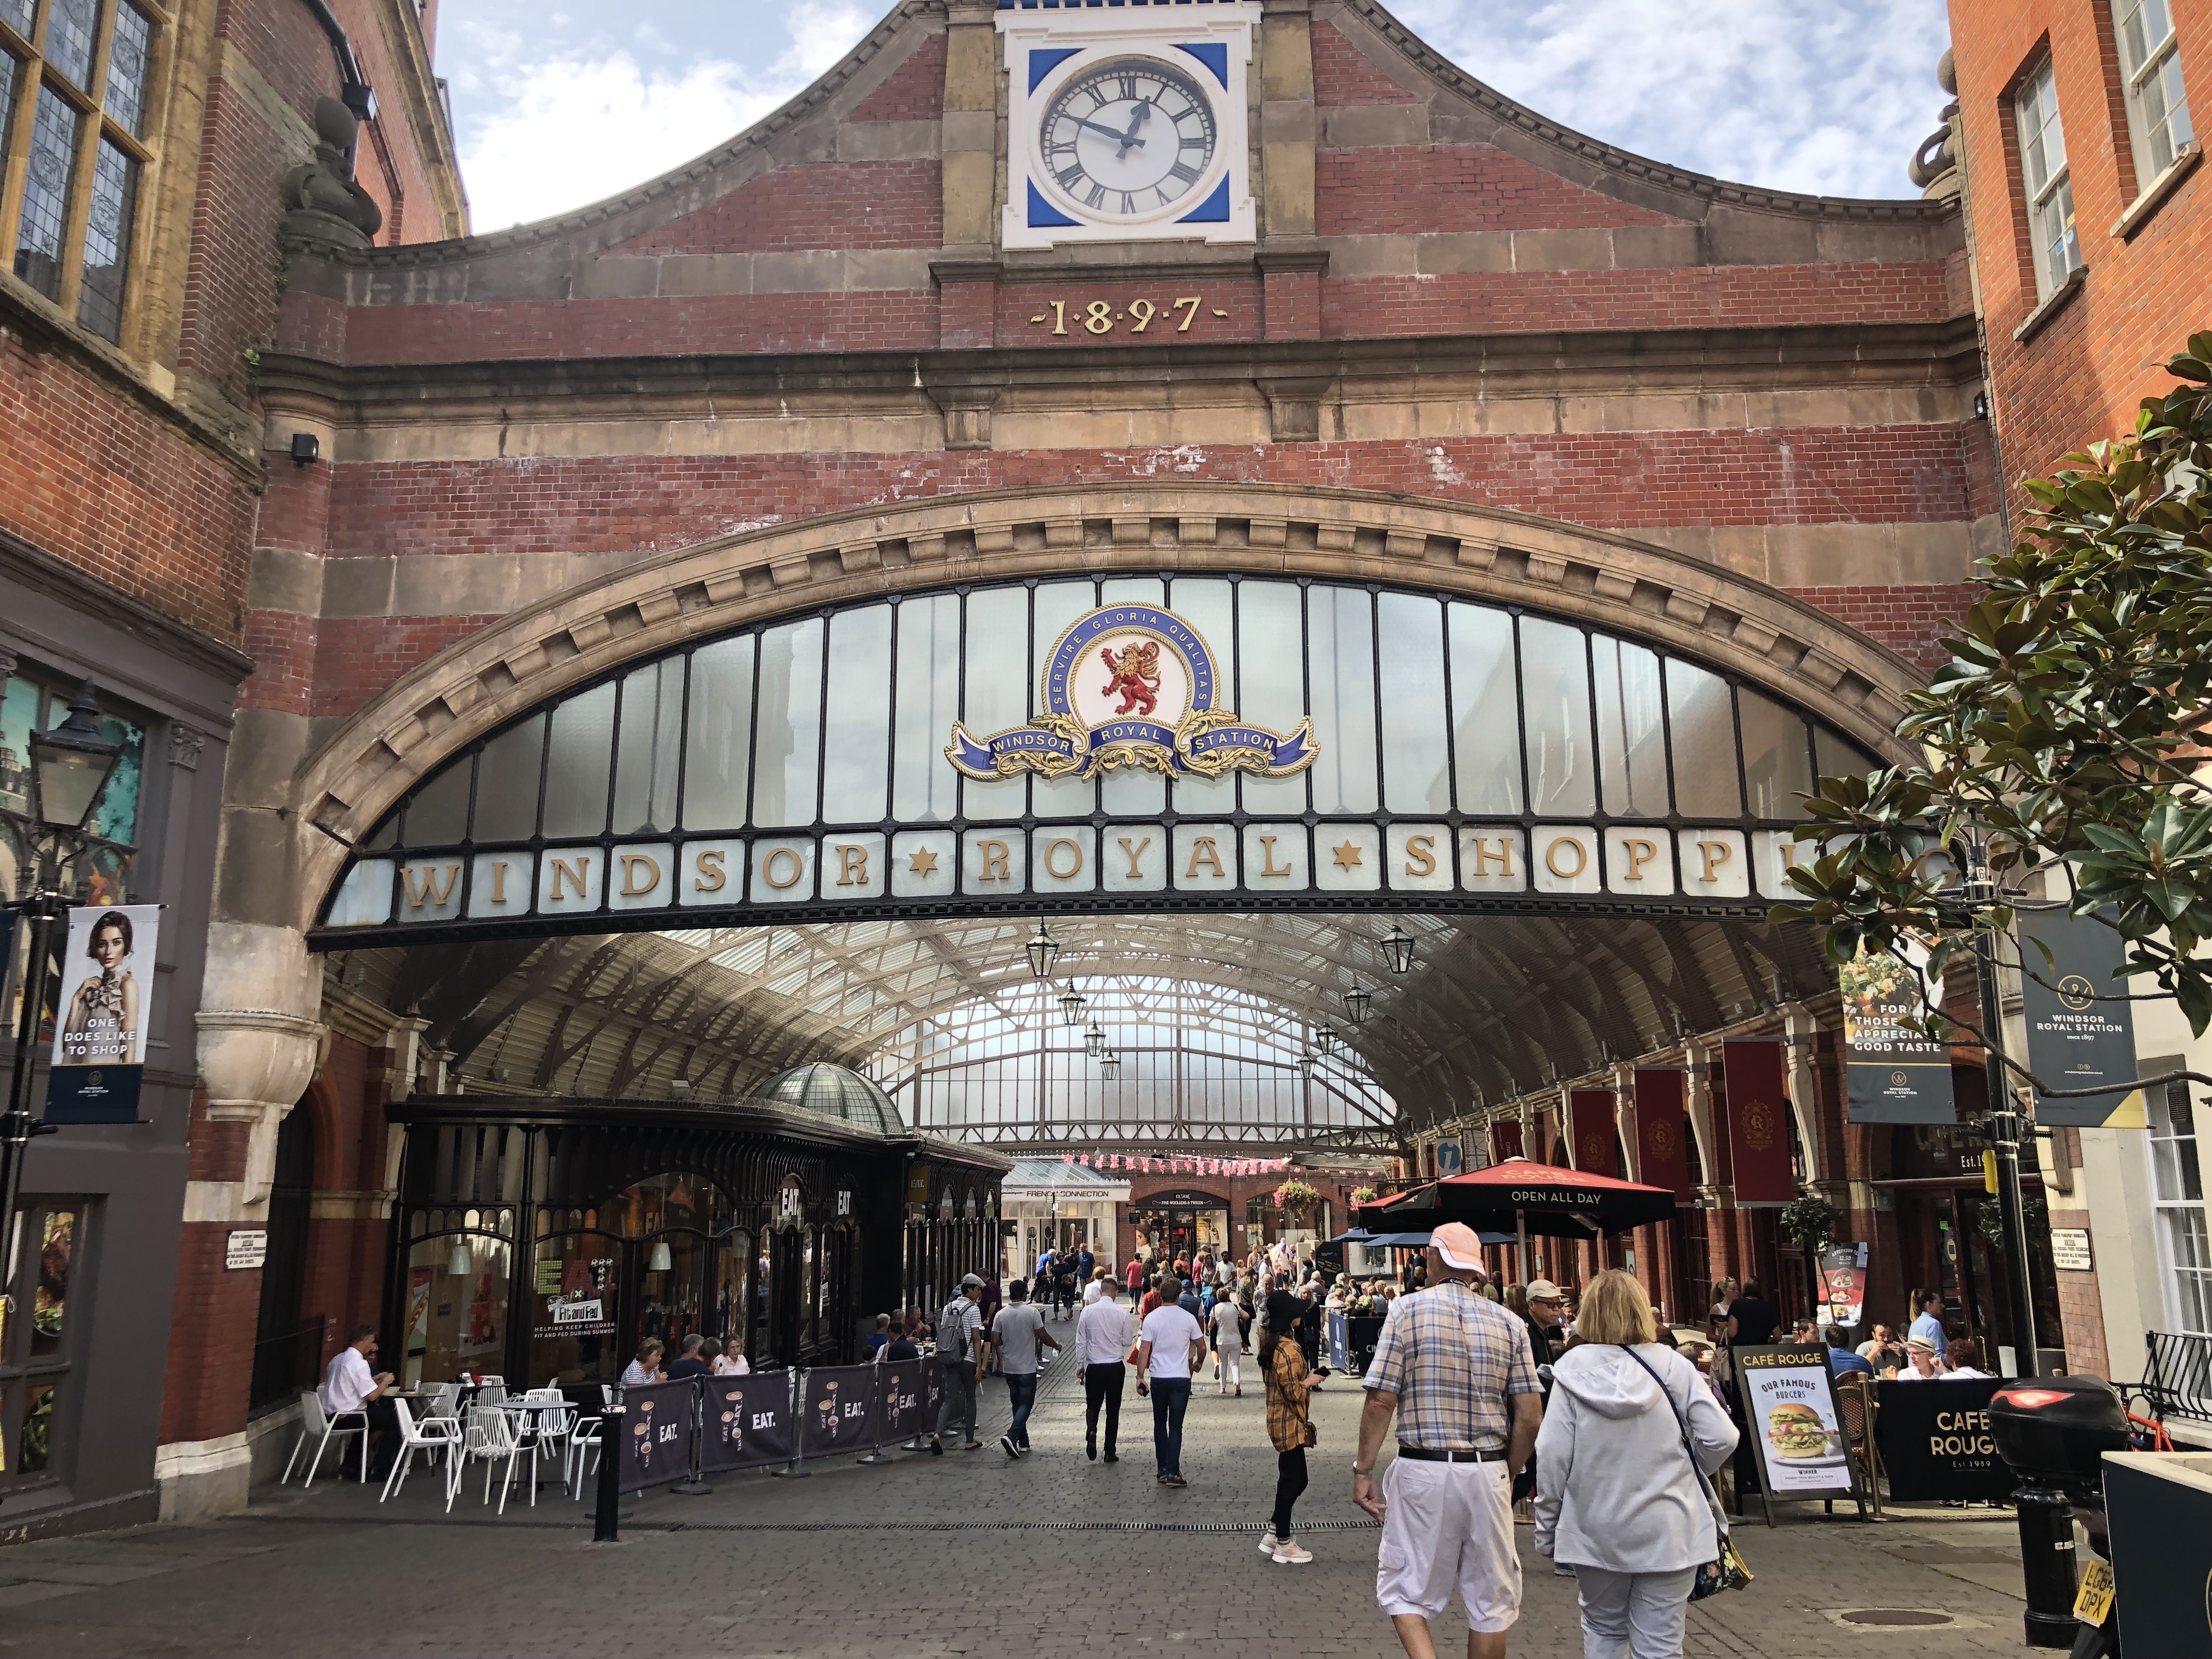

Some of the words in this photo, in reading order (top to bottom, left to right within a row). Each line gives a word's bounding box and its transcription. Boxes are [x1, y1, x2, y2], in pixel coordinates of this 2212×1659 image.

[1053, 634, 1083, 705] SERVIRE
[1092, 612, 1158, 630] GLORIA
[1169, 624, 1208, 702] QUALITAS
[992, 734, 1070, 752] WINDSOR
[1101, 726, 1161, 742] ROYAL
[1194, 731, 1275, 751] STATION
[399, 844, 870, 907] WINDSOR
[977, 836, 1293, 881] ROYAL
[1404, 834, 1962, 890] SHOPPIG
[1880, 1005, 1907, 1014] FOR
[88, 1018, 116, 1028] ONE
[1855, 1016, 1898, 1026] THOSE
[2052, 1014, 2104, 1023] WINDSOR
[2036, 1023, 2072, 1031] ROYAL
[2075, 1024, 2123, 1032] STATION
[65, 1032, 101, 1042] DOES
[105, 1031, 137, 1041] LIKE
[1854, 1029, 1940, 1040] APPRECIAE
[69, 1046, 86, 1056] TO
[91, 1045, 128, 1055] SHOP
[1854, 1042, 1892, 1051] GOOD
[1897, 1042, 1941, 1052] TASTE
[1961, 1155, 1976, 1168] Est.
[1511, 1191, 1547, 1201] OPEN
[1550, 1192, 1573, 1203] ALL
[1577, 1193, 1601, 1204] DAY
[538, 1258, 613, 1294] EAT
[559, 1307, 571, 1321] Fit
[572, 1306, 585, 1320] and
[586, 1305, 599, 1319] Fed
[1743, 1353, 1775, 1366] CAFÉ
[1778, 1352, 1822, 1365] ROUGE
[1761, 1380, 1778, 1392] OUR
[1780, 1379, 1816, 1391] FAMOUS
[899, 1393, 917, 1409] EAT.
[1775, 1390, 1806, 1400] BURGERS
[845, 1402, 865, 1418] EAT.
[752, 1412, 776, 1430] EAT.
[660, 1423, 678, 1443] EAT.
[2079, 1589, 2106, 1618] DPX
